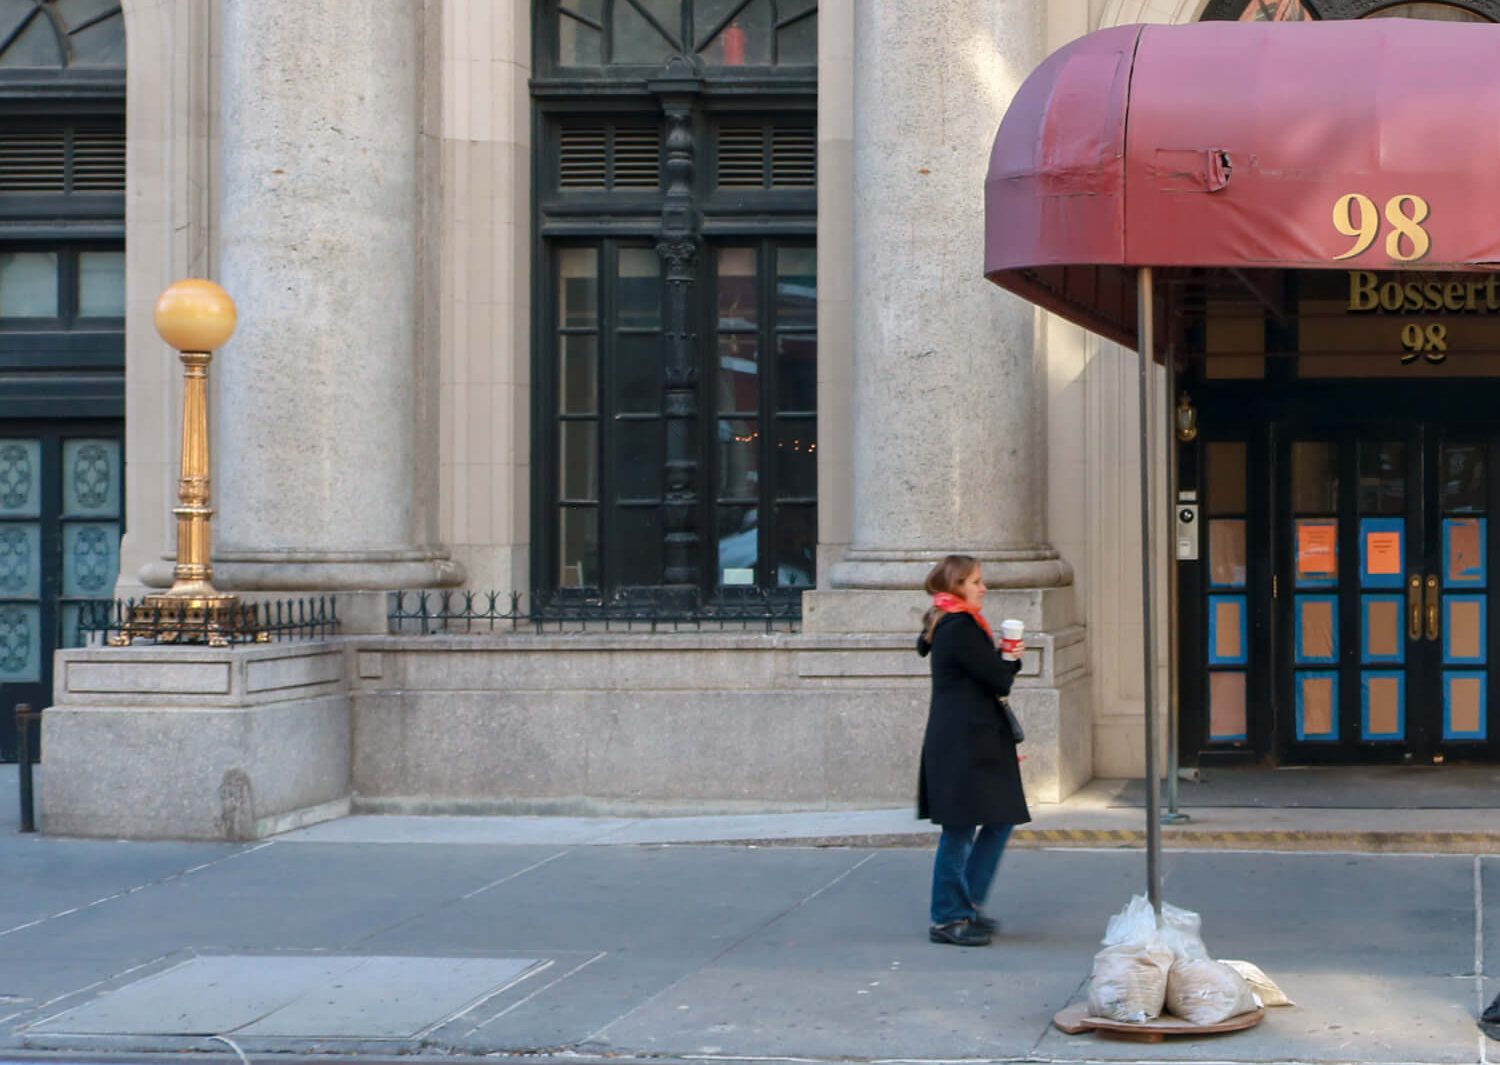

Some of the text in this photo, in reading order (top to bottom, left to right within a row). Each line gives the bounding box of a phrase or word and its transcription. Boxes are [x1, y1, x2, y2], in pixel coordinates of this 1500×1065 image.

[1332, 193, 1430, 261] 98
[1347, 271, 1500, 311] Bossert
[1401, 323, 1447, 360] 98
